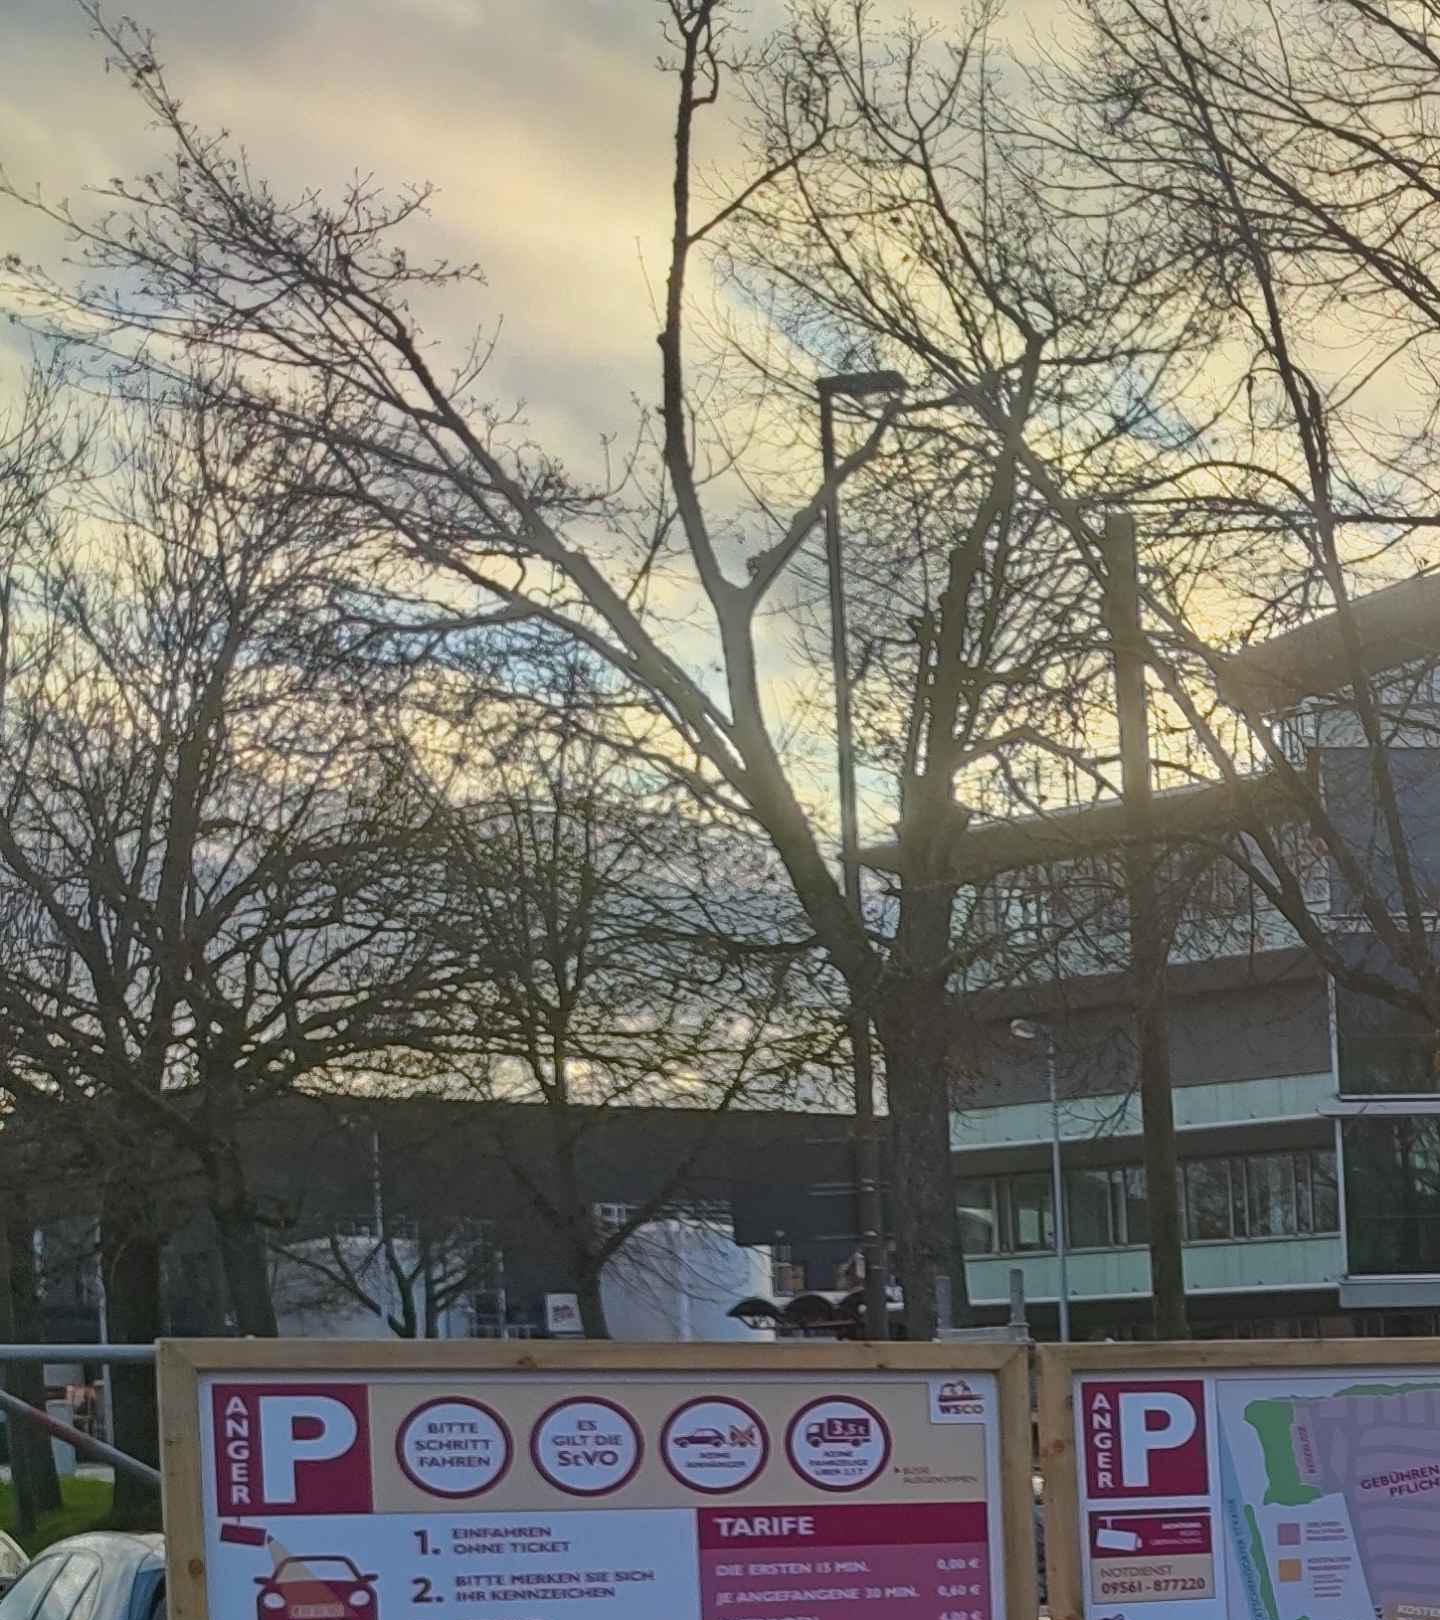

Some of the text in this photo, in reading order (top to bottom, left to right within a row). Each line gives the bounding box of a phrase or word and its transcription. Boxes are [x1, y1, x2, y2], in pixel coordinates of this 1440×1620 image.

[940, 1403, 984, 1415] WSCO
[427, 1421, 479, 1434] BITTE
[578, 1420, 598, 1432] ES
[415, 1438, 492, 1452] SCHRITT
[553, 1434, 624, 1448] GILT DIE
[1090, 1392, 1115, 1489] ANGER
[1118, 1391, 1198, 1488] P
[226, 1396, 252, 1505] ANGER
[259, 1395, 358, 1504] P
[417, 1456, 492, 1469] FAHREN
[557, 1450, 619, 1467] StVO
[452, 1526, 552, 1540] EINFAHREN
[713, 1516, 816, 1537] TARIFE
[413, 1529, 441, 1556] 1.
[454, 1540, 571, 1556] OHNE TICKET
[715, 1563, 744, 1577] DIE
[748, 1562, 812, 1576] ERSTEN
[834, 1560, 872, 1574] MIN.
[967, 1557, 980, 1571] €
[1100, 1564, 1174, 1579] NOTDIENST
[455, 1570, 656, 1588] BITTE MERKEN SIE SICH
[1101, 1578, 1142, 1595] 09561
[1153, 1576, 1206, 1593] 877220
[411, 1577, 444, 1604] 2.
[456, 1586, 616, 1603] IHR KENNZEICHEN
[715, 1592, 738, 1607] JE
[737, 1587, 861, 1604] ANGEFANGENE
[883, 1584, 921, 1599] MIN.
[968, 1583, 981, 1597] €
